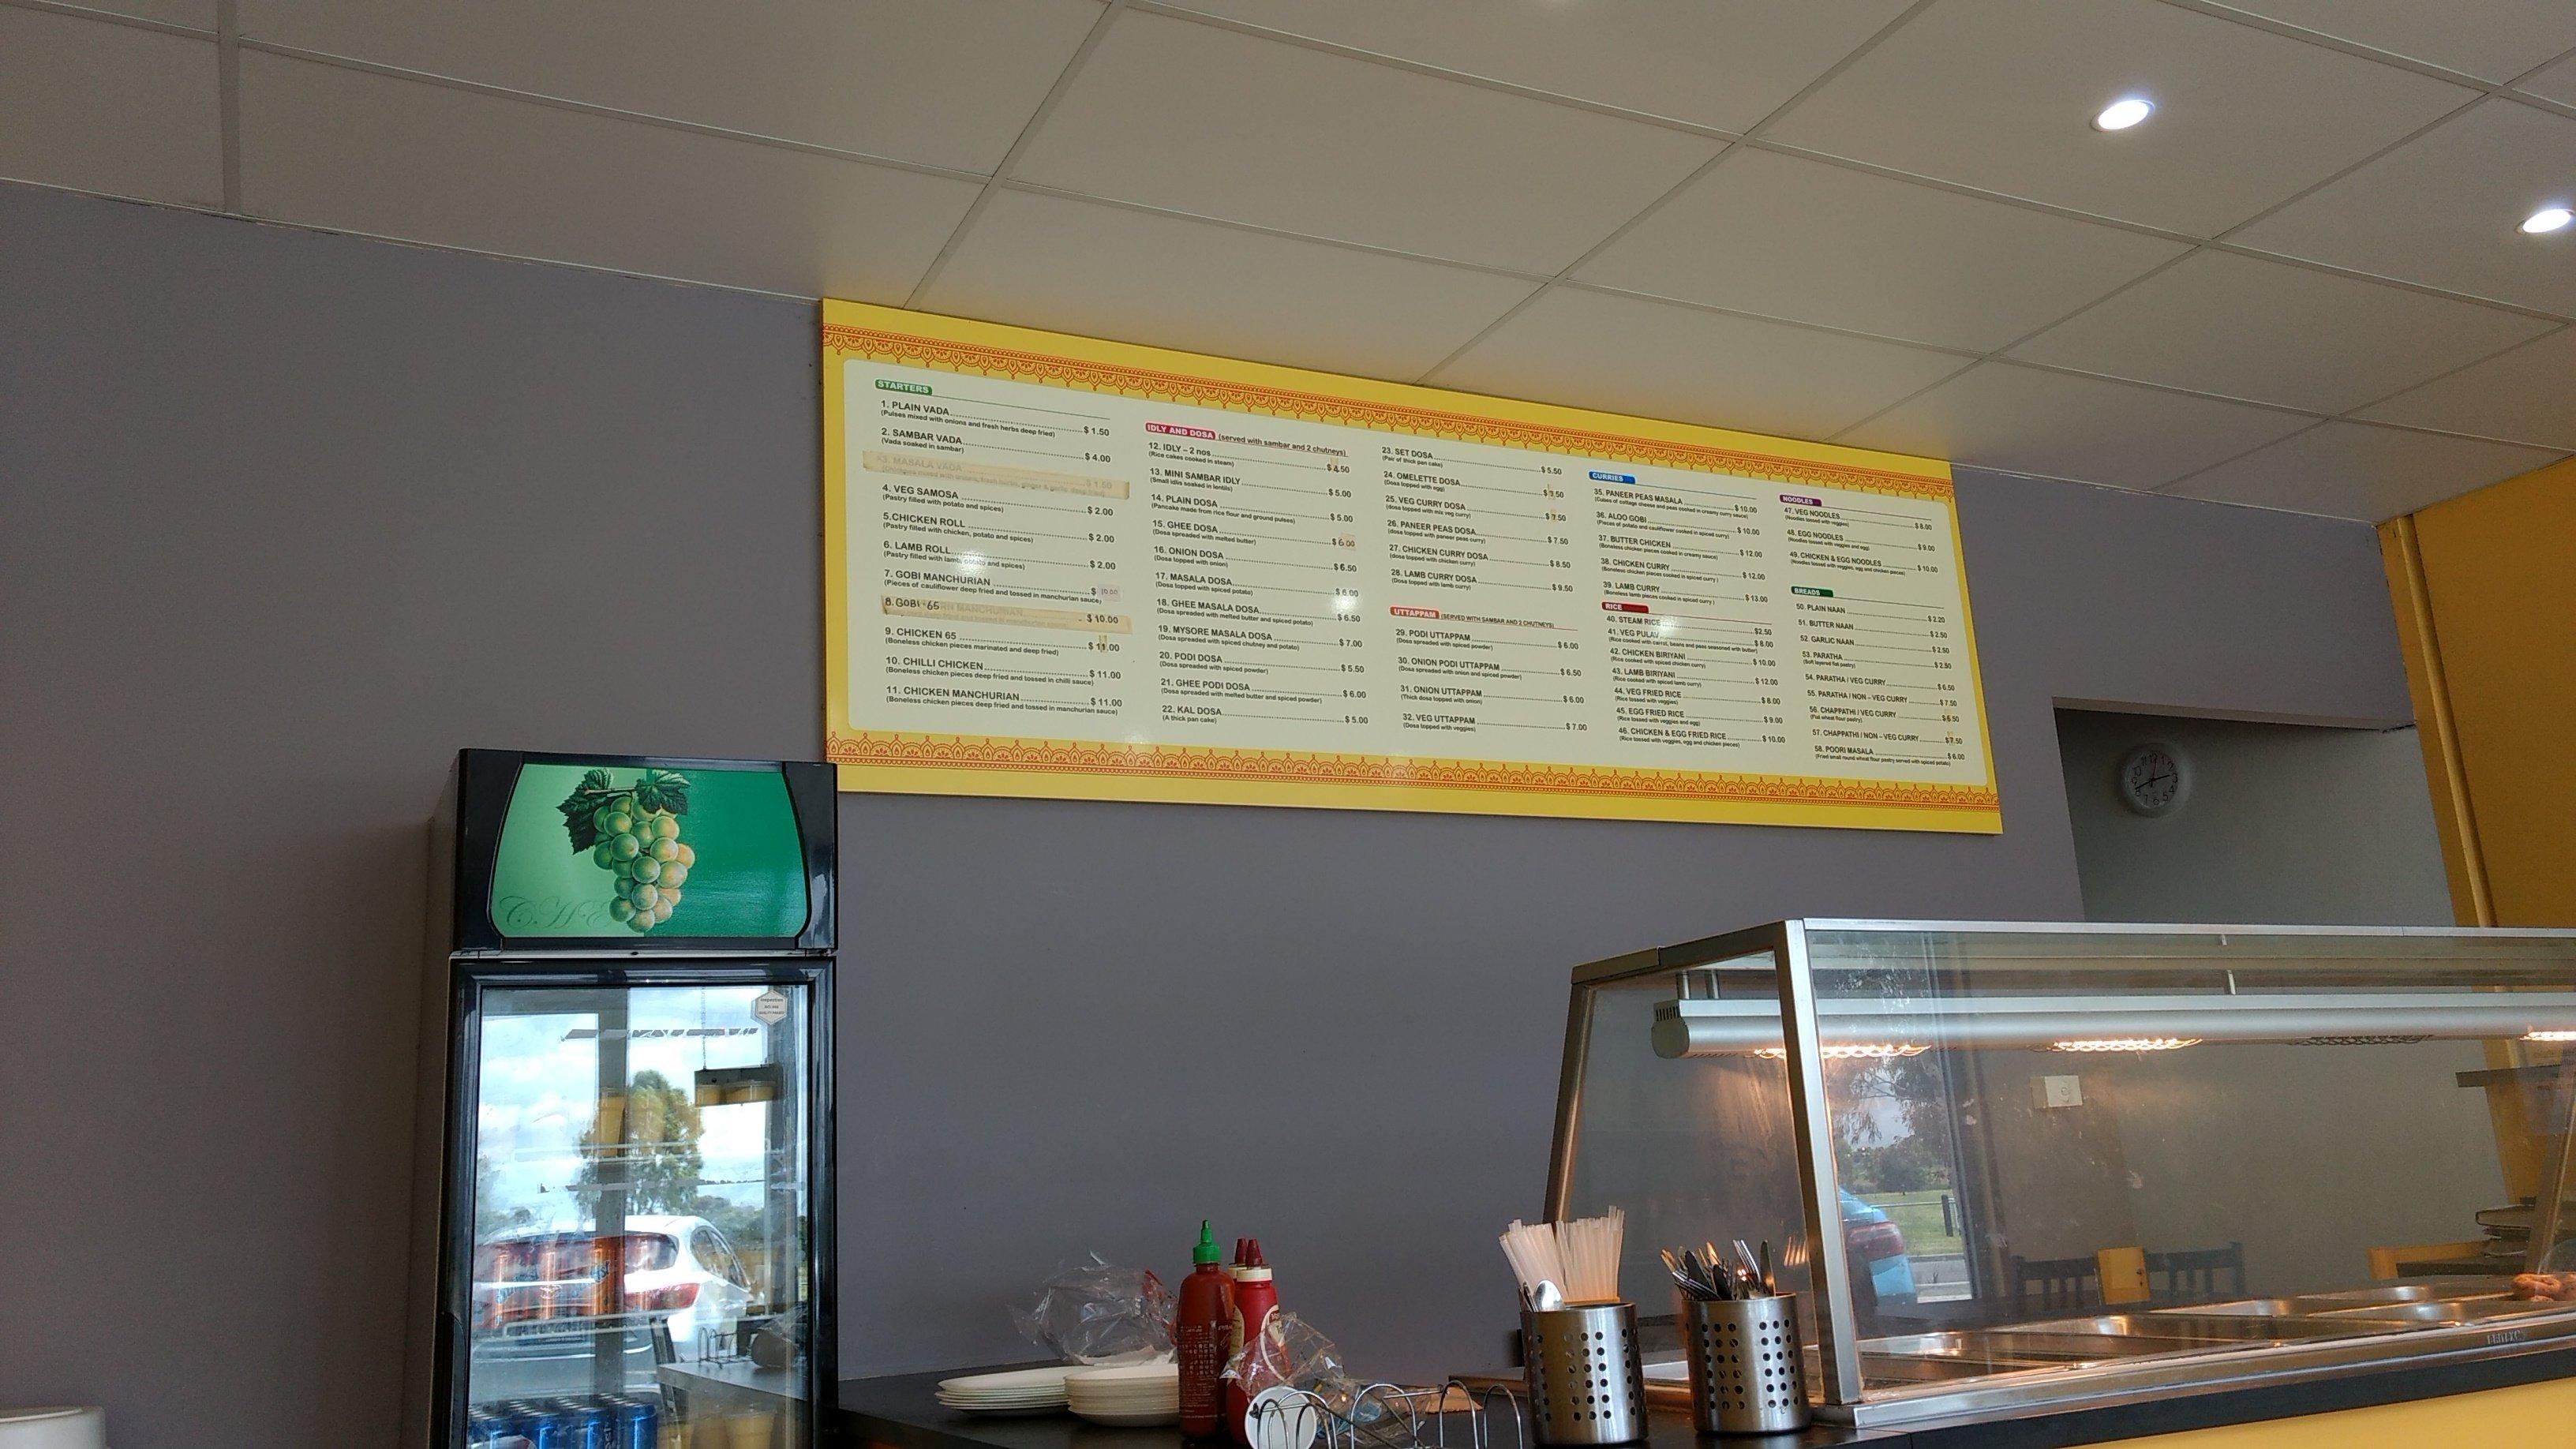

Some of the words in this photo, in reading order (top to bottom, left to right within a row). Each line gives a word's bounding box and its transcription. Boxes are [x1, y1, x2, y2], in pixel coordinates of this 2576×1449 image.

[878, 380, 929, 393] STARTERS
[880, 409, 906, 418] (Pulses
[1000, 424, 1019, 432] herbs
[1037, 429, 1055, 438] fried)
[892, 401, 921, 412] PLAIN
[923, 405, 949, 416] VADA
[1084, 425, 1089, 434] $
[1091, 427, 1110, 436] 1.50
[1147, 424, 1166, 432] IDLY
[1189, 429, 1213, 439] DOSA
[893, 429, 934, 441] SAMBAR
[935, 434, 962, 444] VADA
[1084, 452, 1090, 461] $
[1091, 453, 1110, 462] 4.00
[936, 444, 964, 454] sambar)
[1218, 433, 1245, 444] (served
[1312, 445, 1346, 456] chutneys)
[1164, 469, 1183, 478] MINI
[1185, 471, 1221, 482] SAMBAR
[1222, 476, 1240, 485] IDLY
[1328, 488, 1333, 496] $
[1335, 489, 1351, 498] 5.00
[1592, 472, 1623, 481] CURRIES
[882, 493, 907, 503] (Pastry
[979, 504, 1004, 513] spices)
[893, 485, 914, 494] VEG
[916, 487, 959, 499] SAMOSA
[1087, 505, 1092, 515] $
[1094, 507, 1114, 516] 2.00
[1782, 496, 1813, 504] NOODLES
[1608, 512, 1627, 521] ALOO
[1628, 515, 1646, 523] GOBI
[939, 517, 965, 528] ROLL
[1088, 533, 1094, 542] $
[1095, 534, 1114, 543] 2.00
[1812, 531, 1844, 541] NOODLES
[1402, 545, 1437, 556] CHICKEN
[1439, 549, 1465, 558] CURRY
[1466, 552, 1488, 560] DOSA
[895, 570, 921, 579] GOBI
[923, 572, 990, 586] MANCHURIAN
[1091, 587, 1096, 596] $
[1171, 599, 1196, 608] GHEE
[1197, 601, 1234, 612] MASALA
[1234, 605, 1260, 614] DOSA
[1394, 608, 1436, 617] UTTAPPAM
[896, 627, 942, 638] CHICKEN
[945, 631, 957, 640] 65
[1088, 641, 1094, 650] $
[1095, 642, 1120, 652] 11.00
[1409, 629, 1428, 638] PODI
[1429, 631, 1470, 641] UTTAPPAM
[1810, 635, 1835, 644] GARLIC
[1174, 652, 1196, 661] PODI
[1197, 653, 1222, 663] DOSA
[1341, 663, 1346, 672] $
[1347, 665, 1365, 673] 5.50
[1621, 647, 1654, 657] CHICKEN
[1655, 650, 1686, 660] BIRIYANI
[903, 657, 935, 667] CHILLI
[938, 659, 983, 670] CHICKEN
[1089, 669, 1095, 678] $
[1097, 670, 1121, 679] 11.00
[1177, 706, 1195, 714] KAL
[1196, 706, 1222, 715] DOSA
[1344, 715, 1350, 724] $
[1351, 716, 1368, 724] 5.00
[1415, 713, 1432, 722] VEG
[1433, 714, 1475, 724] UTTAPPAM
[1571, 722, 1587, 731] 7.00
